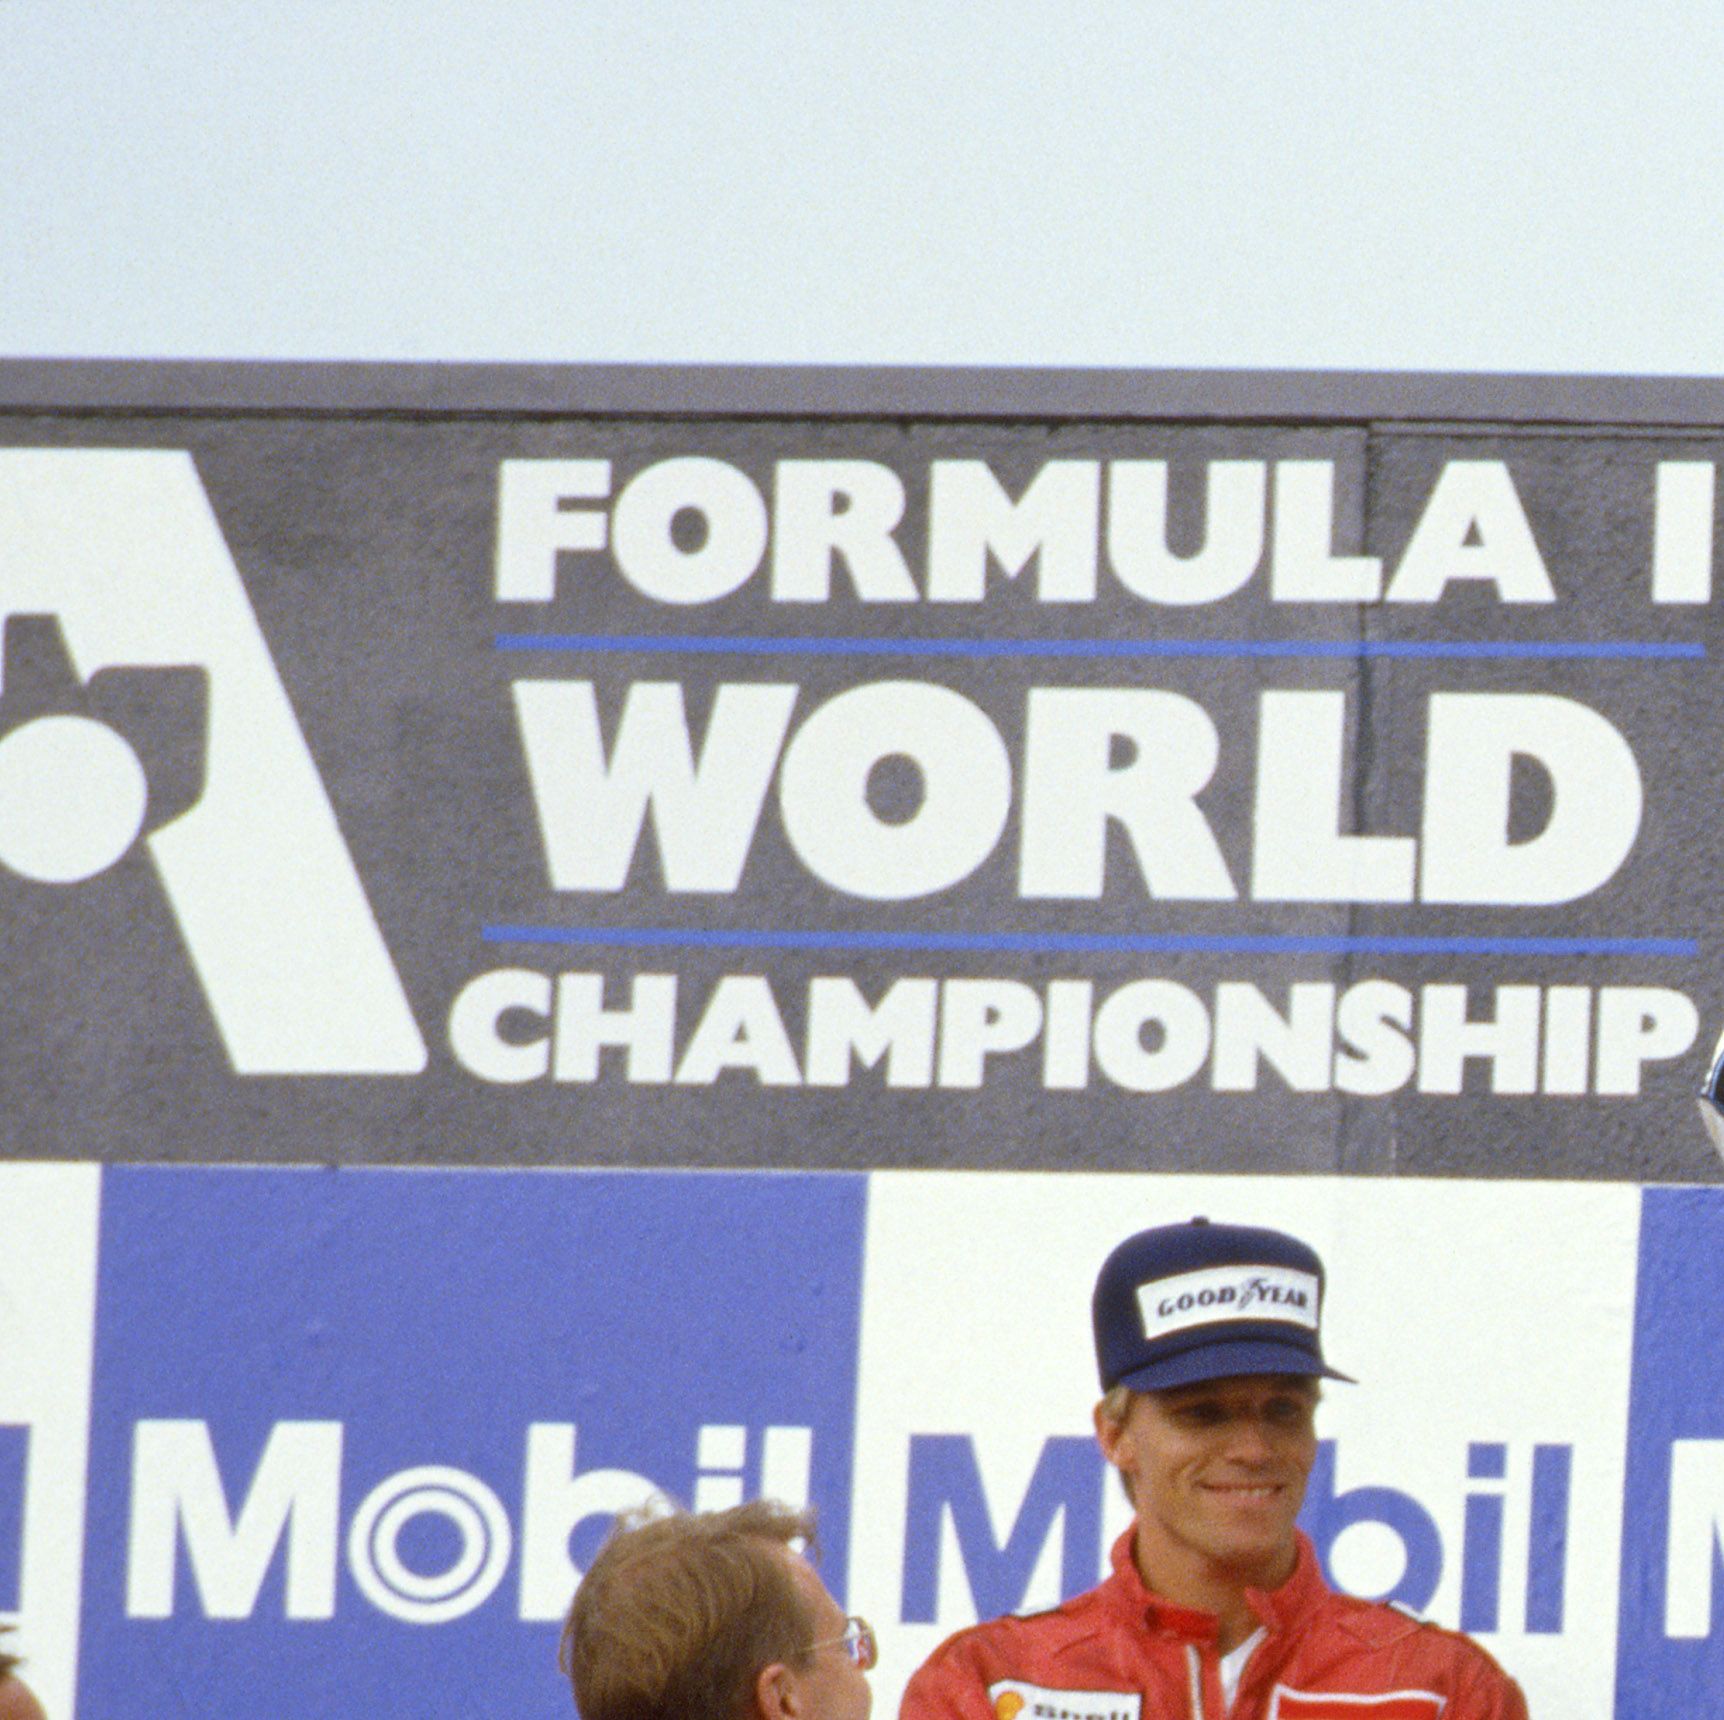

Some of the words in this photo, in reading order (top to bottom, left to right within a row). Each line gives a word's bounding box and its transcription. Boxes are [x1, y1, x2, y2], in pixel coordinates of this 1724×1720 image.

[494, 456, 1557, 605] FORMULA
[511, 680, 1643, 907] WORLD
[448, 968, 1700, 1097] CHAMPIONSHIP
[900, 1433, 1573, 1635] Mbil
